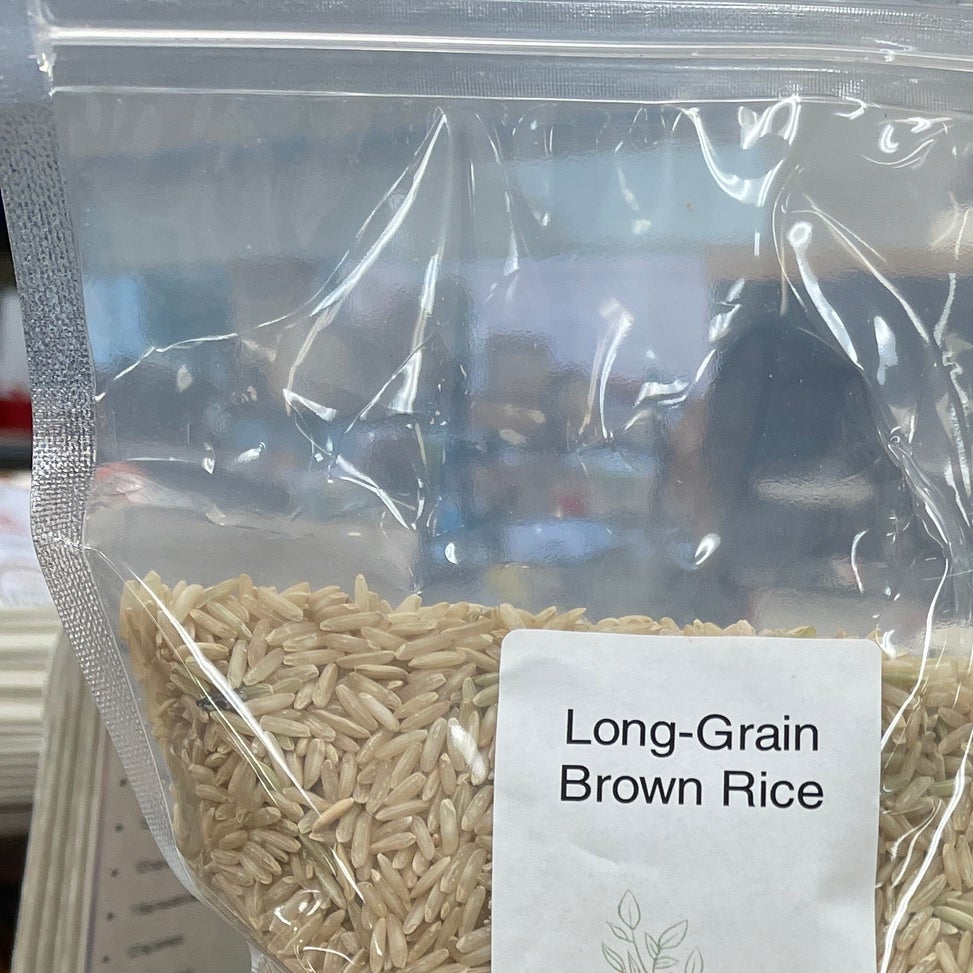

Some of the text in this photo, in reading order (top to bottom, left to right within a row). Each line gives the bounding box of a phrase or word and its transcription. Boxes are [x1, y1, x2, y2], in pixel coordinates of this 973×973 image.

[566, 708, 819, 758] Long-Grain
[560, 764, 824, 810] Brown Rice
